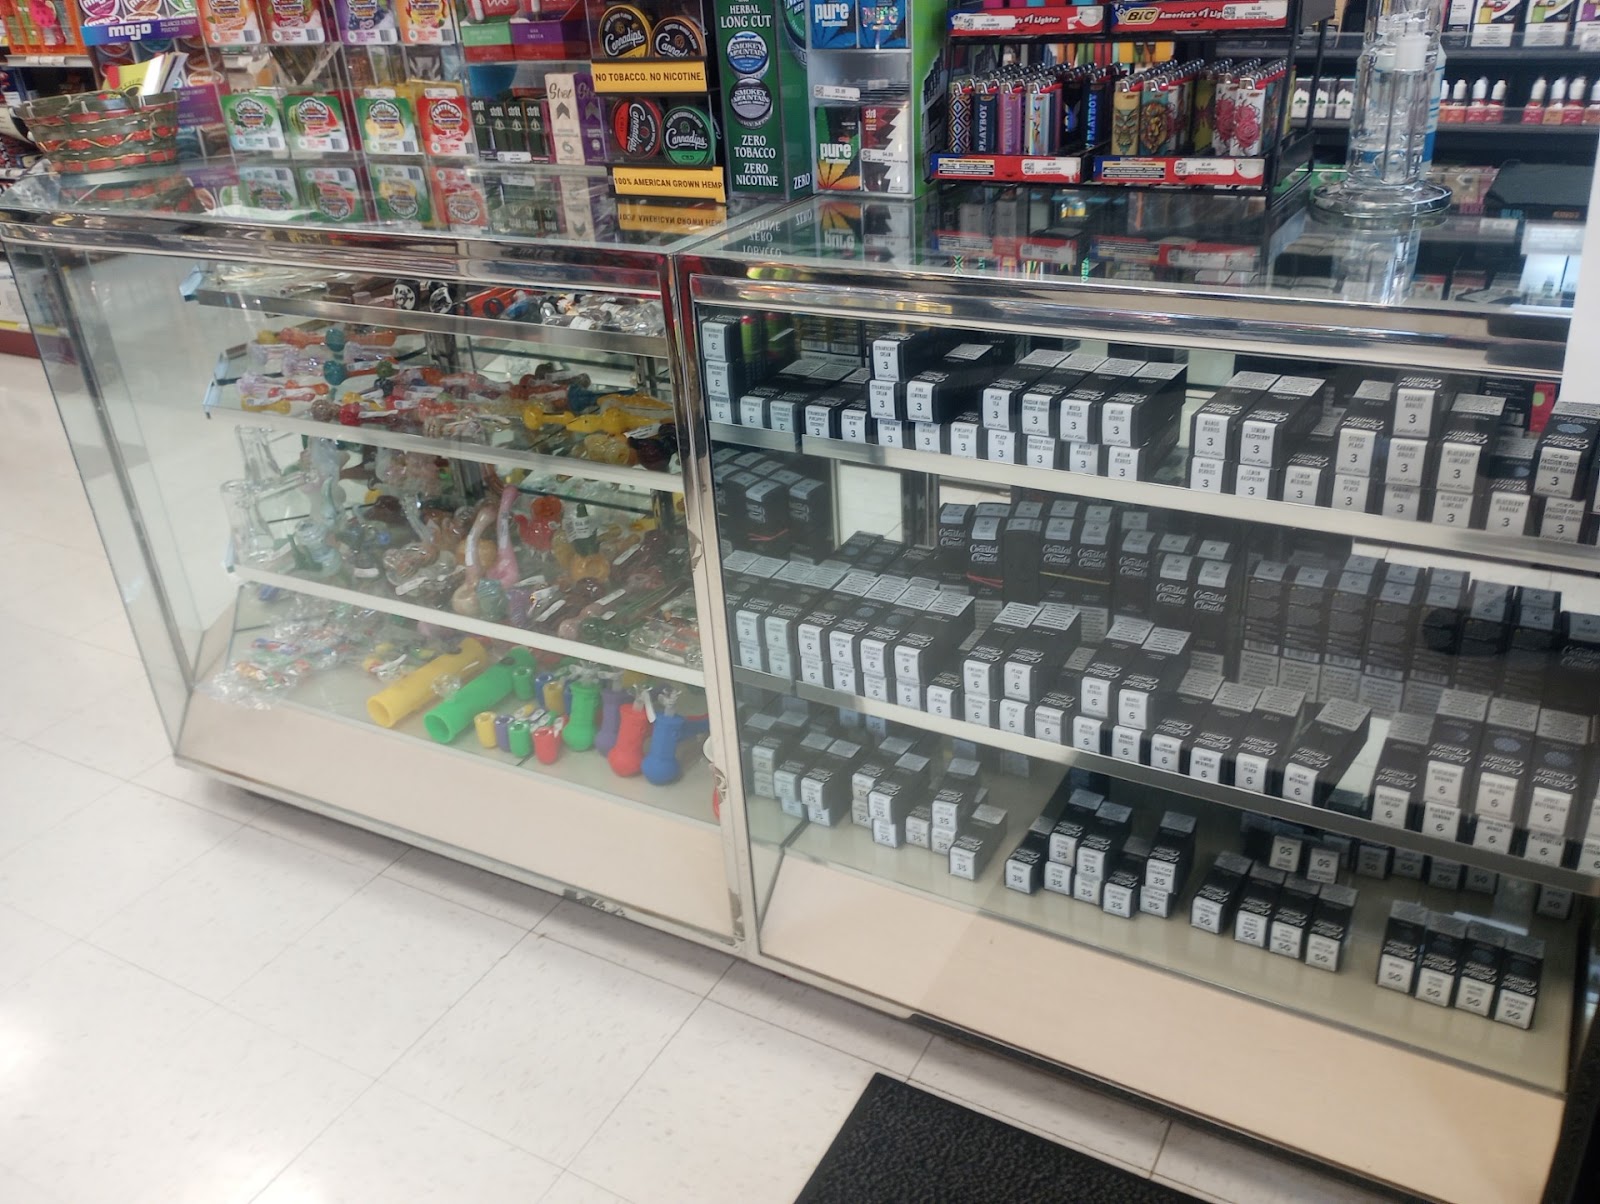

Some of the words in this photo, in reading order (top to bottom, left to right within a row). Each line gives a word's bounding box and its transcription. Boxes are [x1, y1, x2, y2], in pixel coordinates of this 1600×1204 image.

[730, 4, 760, 14] HERBAL
[814, 3, 849, 24] pure
[1034, 16, 1060, 25] Lighter
[1126, 10, 1156, 21] BIC
[1159, 11, 1197, 20] America's
[721, 16, 748, 28] LONG
[751, 15, 771, 27] CUT
[108, 23, 152, 40] mojo
[604, 27, 645, 56] Cannadips
[731, 42, 764, 50] SMOKEY
[729, 48, 765, 57] MOUNTAIN
[595, 72, 607, 82] NO
[608, 72, 648, 81] TOBACCO.
[650, 72, 662, 81] NO
[663, 71, 704, 81] NICOTINE.
[734, 88, 767, 97] SMOKEY
[733, 95, 770, 103] MOUNTAIN
[1087, 93, 1097, 142] PLAYBOY
[627, 103, 646, 153] Cannadips
[978, 104, 988, 152] PLAYBOY
[1004, 105, 1013, 153] PLAYBOY
[666, 128, 708, 150] Cannadips
[741, 135, 766, 147] ZERO
[734, 146, 776, 159] TOBACCO
[820, 143, 852, 160] pure
[743, 163, 768, 174] ZERO
[614, 177, 632, 185] 100%
[633, 178, 671, 187] AMERICAN
[673, 179, 700, 188] GROWN
[701, 180, 723, 189] HEMP
[736, 174, 779, 187] NICOTINE
[793, 172, 811, 190] ZERO
[883, 361, 889, 370] 3
[879, 399, 885, 409] 3
[916, 402, 923, 411] 3
[993, 410, 999, 419] 3
[1408, 413, 1417, 424] 3
[1032, 415, 1039, 425] 3
[1070, 421, 1077, 430] 3
[1113, 425, 1120, 435] 3
[815, 428, 821, 436] 3
[850, 429, 857, 438] 3
[887, 435, 894, 443] 3
[924, 437, 931, 446] 3
[1206, 437, 1214, 447] 3
[960, 442, 967, 452] 3
[1252, 444, 1260, 454] 3
[998, 449, 1004, 458] 3
[1350, 453, 1358, 463] 3
[1036, 454, 1043, 464] 3
[1080, 459, 1087, 469] 3
[1119, 468, 1126, 477] 3
[1400, 463, 1409, 473] 3
[1453, 468, 1461, 479] 3
[1202, 478, 1209, 488] 3
[1550, 476, 1560, 486] 3
[1247, 486, 1255, 496] 3
[1295, 490, 1304, 499] 3
[1345, 496, 1353, 506] 3
[1396, 503, 1405, 514] 3
[1447, 513, 1455, 523] 3
[1501, 517, 1510, 528] 3
[1555, 524, 1565, 534] 3
[970, 543, 999, 556] Coastal
[1042, 543, 1072, 555] Coastal
[1077, 548, 1108, 560] Coastal
[970, 553, 999, 564] Clouds
[1043, 553, 1071, 565] Clouds
[1078, 556, 1107, 569] Clouds
[1155, 582, 1188, 595] Coastal
[1156, 592, 1186, 606] Clouds
[1193, 589, 1227, 603] Coastal
[1194, 600, 1225, 614] Clouds
